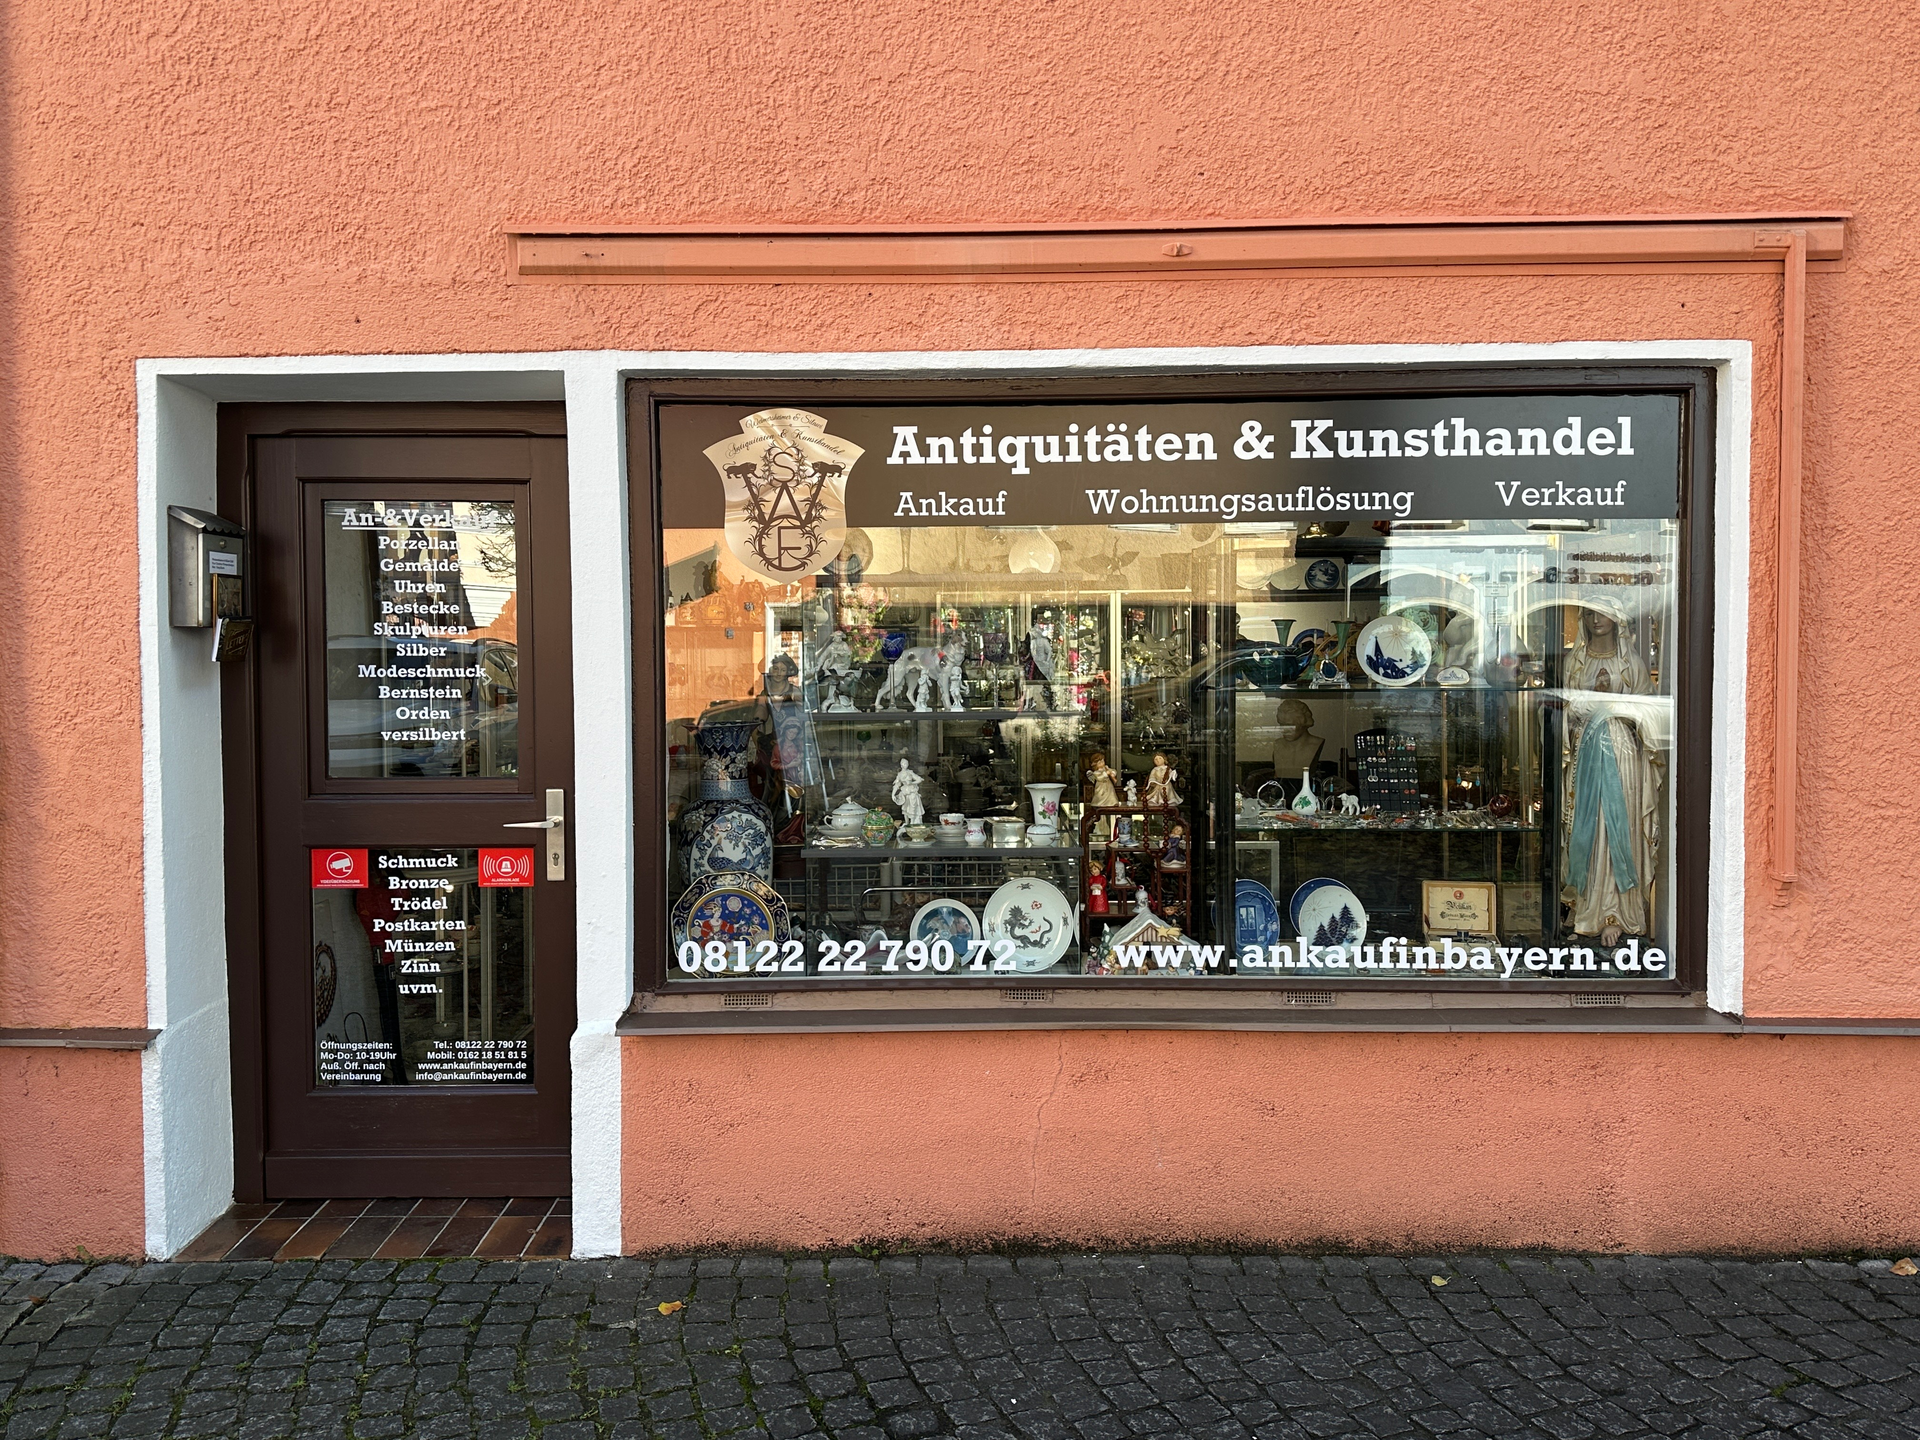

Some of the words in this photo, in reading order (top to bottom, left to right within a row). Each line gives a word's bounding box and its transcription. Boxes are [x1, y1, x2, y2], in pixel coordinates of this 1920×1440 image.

[791, 428, 845, 455] Kunsthandel
[886, 423, 1218, 475] Antiquitäten
[1233, 420, 1275, 460] &
[1290, 416, 1634, 460] Kunsthandel
[893, 490, 1008, 517] Ankauf
[1085, 486, 1415, 520] Wohnungsauflösung
[1494, 481, 1628, 508] Verkauf
[378, 536, 461, 550] Porzellan
[380, 558, 460, 572] Gemälde
[393, 580, 446, 593] Uhren
[381, 601, 460, 614] Bestecke
[373, 622, 468, 638] Skulpturen
[396, 644, 447, 657] Silber
[357, 665, 487, 678] Modeschmuck
[378, 685, 462, 699] Bernstein
[395, 706, 451, 720] Orden
[381, 728, 466, 741] versilbert
[378, 854, 458, 869] Schmuck
[388, 876, 449, 889] Bronze
[390, 897, 448, 911] Trödel
[372, 917, 467, 932] Postkarten
[384, 938, 456, 952] Münzen
[678, 939, 804, 973] 08122
[817, 939, 868, 972] 22
[880, 939, 955, 972] 790
[967, 939, 1017, 972] 72
[1113, 937, 1667, 978] www.ankaufinbayern.de
[400, 960, 441, 973] Zinn
[398, 983, 443, 994] uvm.
[320, 1040, 393, 1051] Öffnungszeiten:
[433, 1041, 453, 1049] Tel.:
[455, 1041, 482, 1049] 08122
[484, 1041, 495, 1049] 22
[497, 1041, 514, 1049] 790
[516, 1041, 527, 1049] 72
[320, 1052, 353, 1060] Mo-Do:
[355, 1051, 397, 1060] 10-19Uhr
[427, 1051, 456, 1060] Mobil:
[457, 1051, 480, 1060] 0162
[481, 1051, 493, 1060] 18
[494, 1051, 506, 1060] 51
[507, 1051, 519, 1060] 81
[521, 1051, 527, 1059] 5
[320, 1061, 342, 1070] Auß.
[344, 1060, 361, 1070] Öff.
[363, 1061, 386, 1070] nach
[418, 1061, 527, 1071] www.ankaufinbayern.de
[320, 1072, 382, 1082] Vereinbarung
[415, 1072, 527, 1081] info@ankaufinbayern.de
